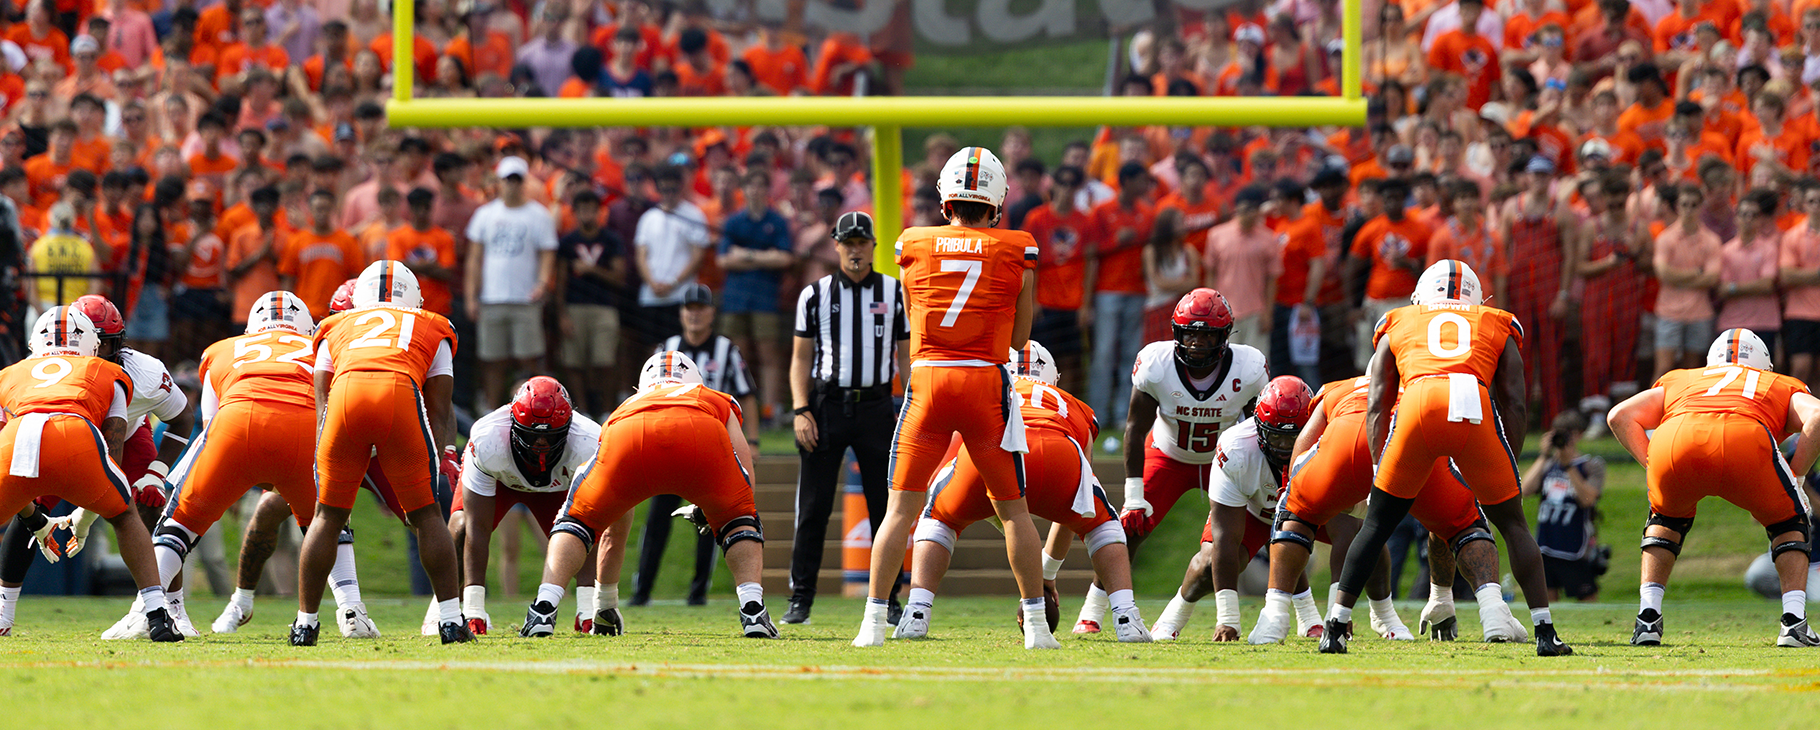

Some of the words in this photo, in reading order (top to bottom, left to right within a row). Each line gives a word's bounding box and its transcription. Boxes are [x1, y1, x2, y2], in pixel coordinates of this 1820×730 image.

[935, 237, 983, 255] PRIBULA
[832, 304, 840, 313] S
[940, 260, 983, 327] 7
[348, 310, 416, 352] 21
[875, 325, 884, 337] U
[1427, 312, 1472, 358] 0
[232, 333, 315, 375] 52
[31, 357, 73, 388] 9
[1232, 378, 1242, 393] C
[1701, 366, 1761, 400] 71
[1176, 405, 1190, 415] NC
[1191, 407, 1223, 418] STATE
[1177, 419, 1221, 453] 15
